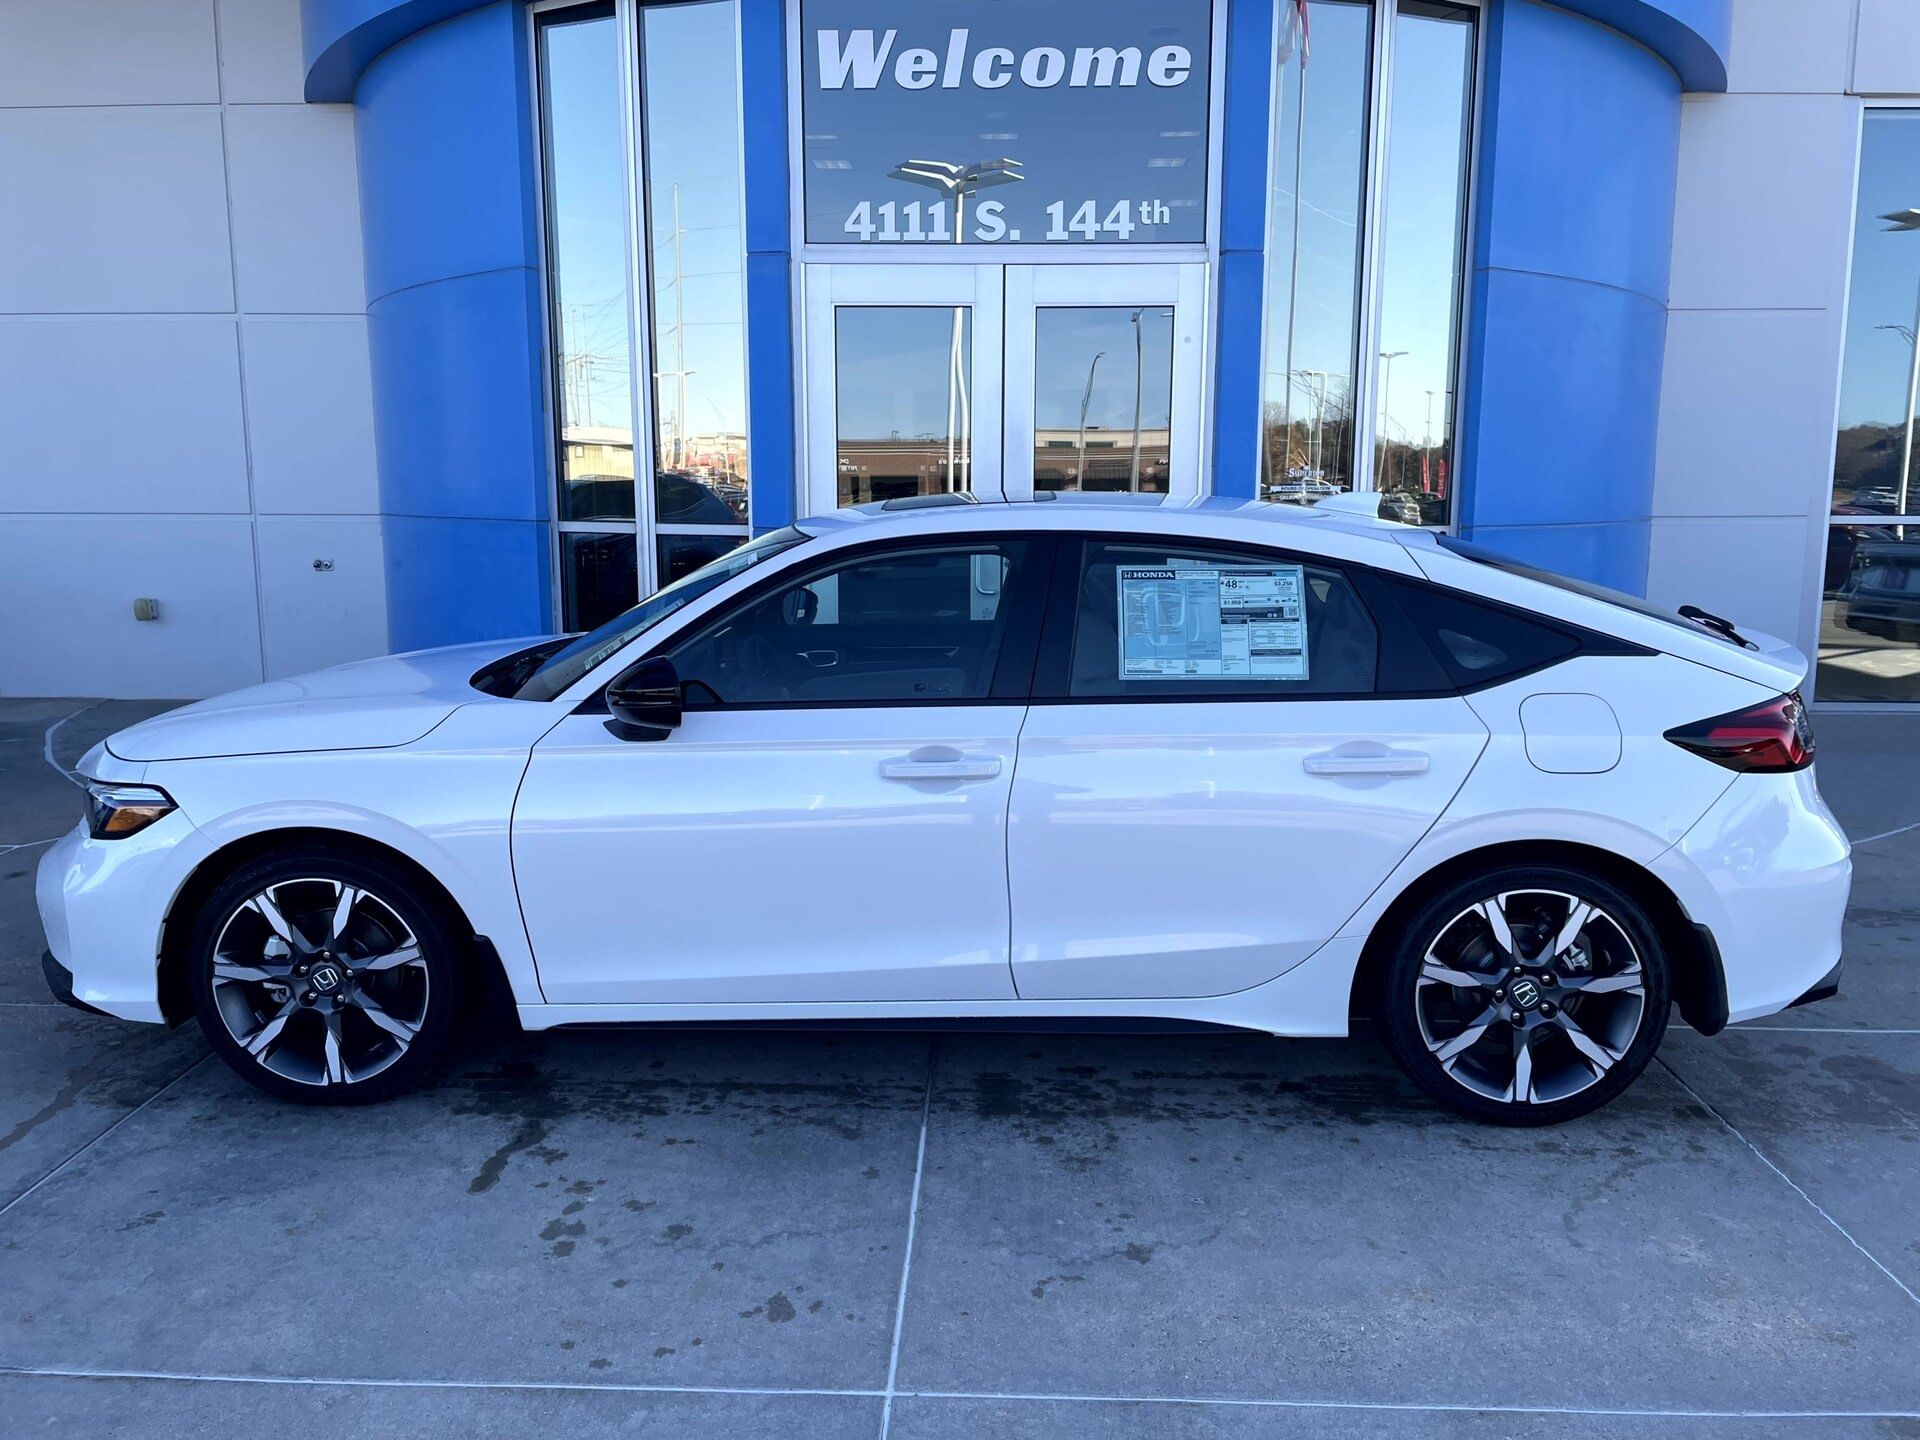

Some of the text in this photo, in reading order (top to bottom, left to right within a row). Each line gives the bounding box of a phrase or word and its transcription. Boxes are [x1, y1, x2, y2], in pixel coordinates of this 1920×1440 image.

[817, 28, 1192, 89] Welcome
[844, 199, 1170, 242] 4111 S. 144th
[1225, 580, 1238, 589] 48
